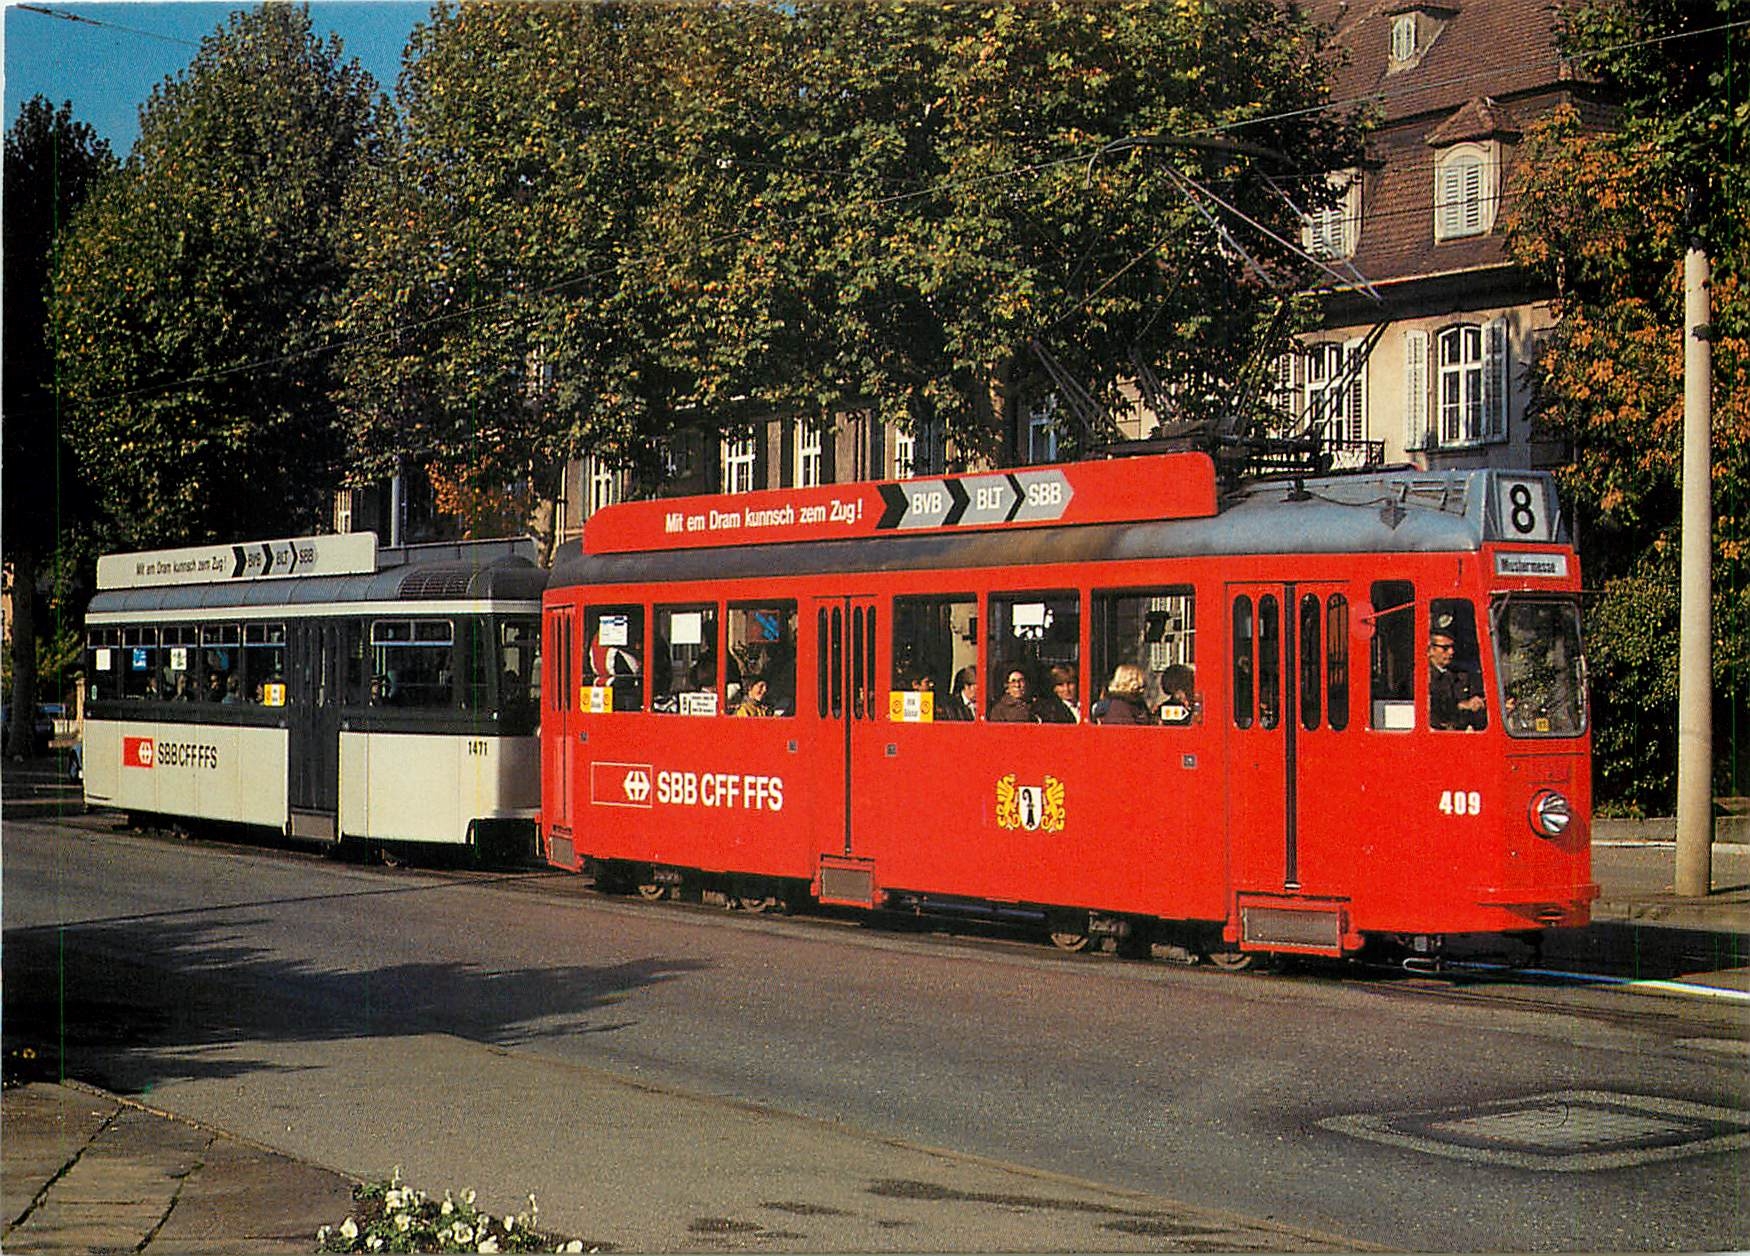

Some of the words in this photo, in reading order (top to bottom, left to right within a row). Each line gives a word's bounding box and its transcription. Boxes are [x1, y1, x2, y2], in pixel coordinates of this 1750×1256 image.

[911, 491, 943, 515] BVB
[976, 487, 1004, 511] BLT
[1028, 482, 1062, 507] SBB
[665, 513, 684, 533] Mit
[687, 516, 705, 531] em
[709, 509, 740, 531] Dram
[745, 504, 794, 527] kunnsch
[800, 506, 826, 524] zem
[1509, 483, 1536, 534] 8
[247, 552, 262, 568] BVB
[275, 550, 289, 566] BLT
[298, 548, 314, 564] SBB
[468, 741, 488, 756] 1471
[657, 771, 698, 805] SBB
[700, 773, 740, 808] CFF
[743, 775, 784, 811] FFS
[1438, 790, 1481, 816] 409
